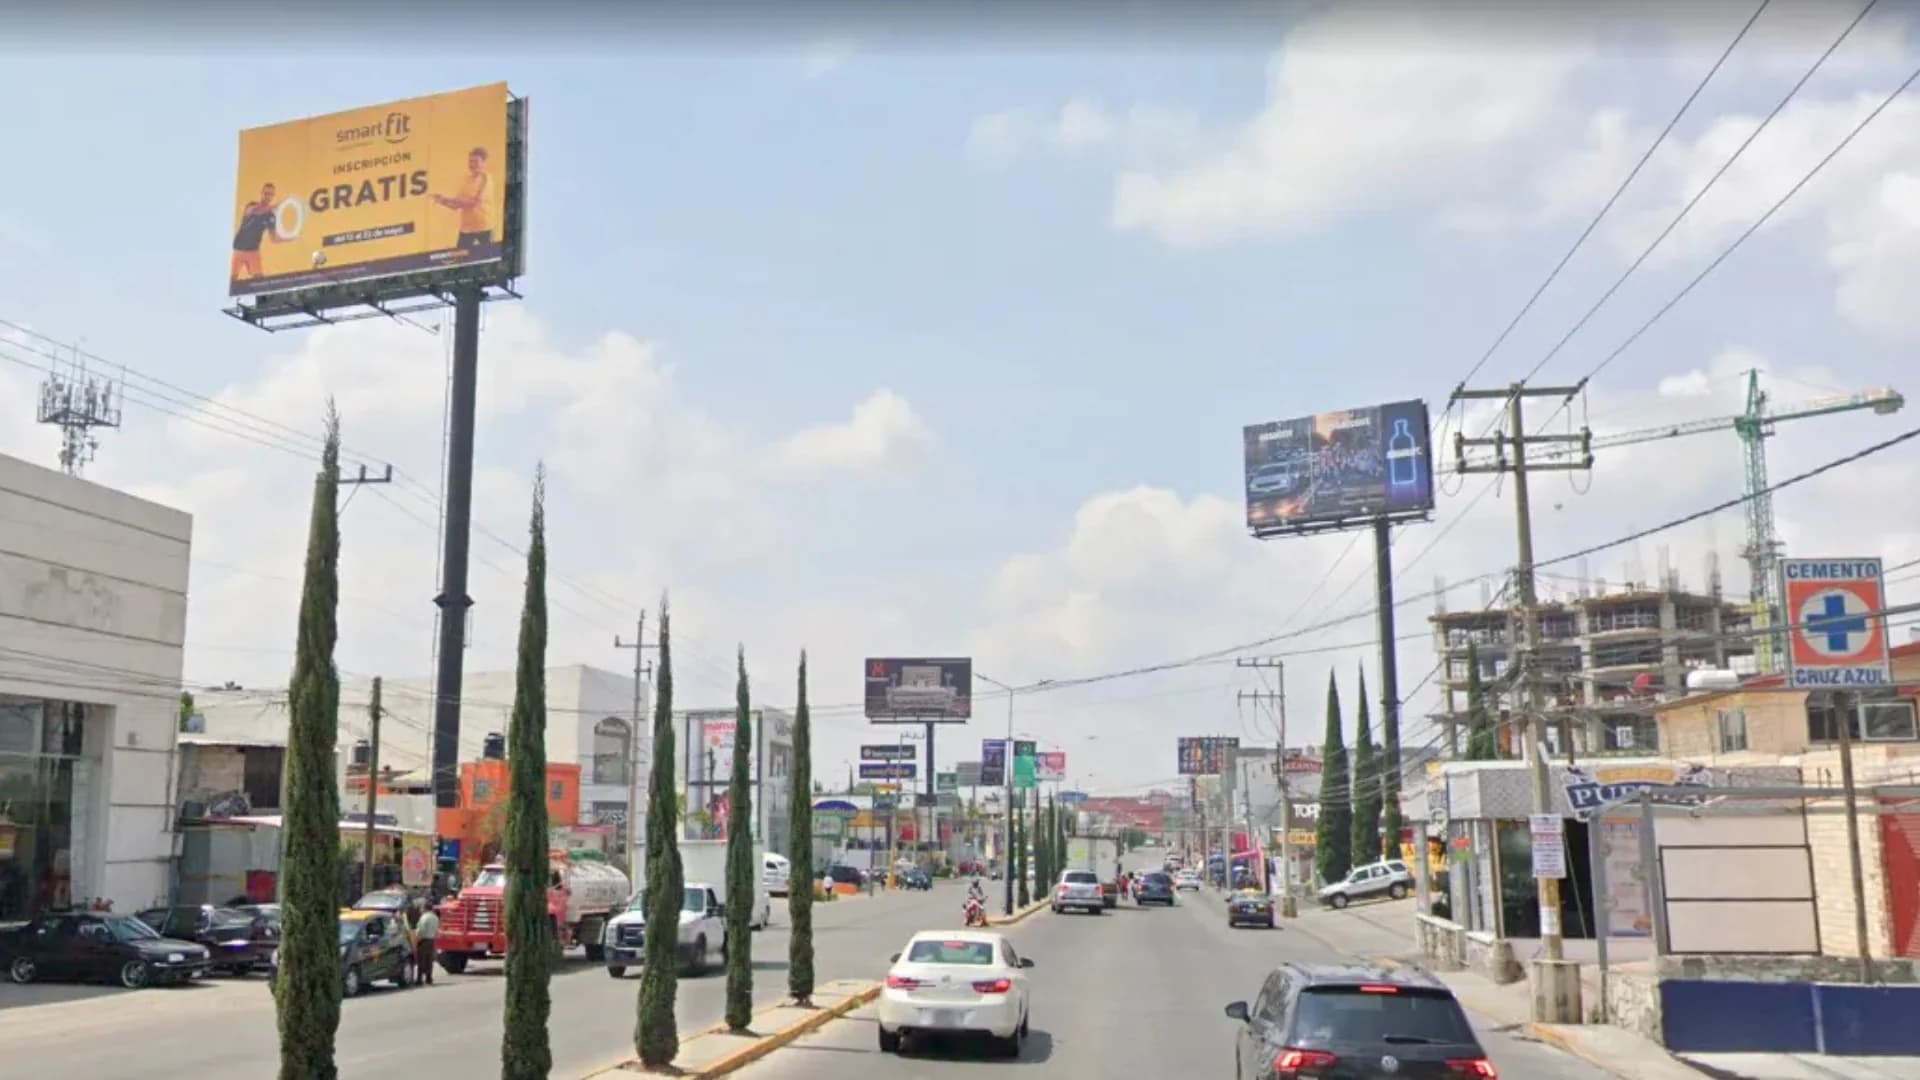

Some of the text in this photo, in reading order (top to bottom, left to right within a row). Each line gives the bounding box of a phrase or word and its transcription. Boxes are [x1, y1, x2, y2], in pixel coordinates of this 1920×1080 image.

[333, 152, 411, 175] INSCRIPCIÓN
[309, 171, 428, 213] GRATIS
[1786, 562, 1879, 579] CEMENTO
[1795, 667, 1887, 685] CRUZ AZUL
